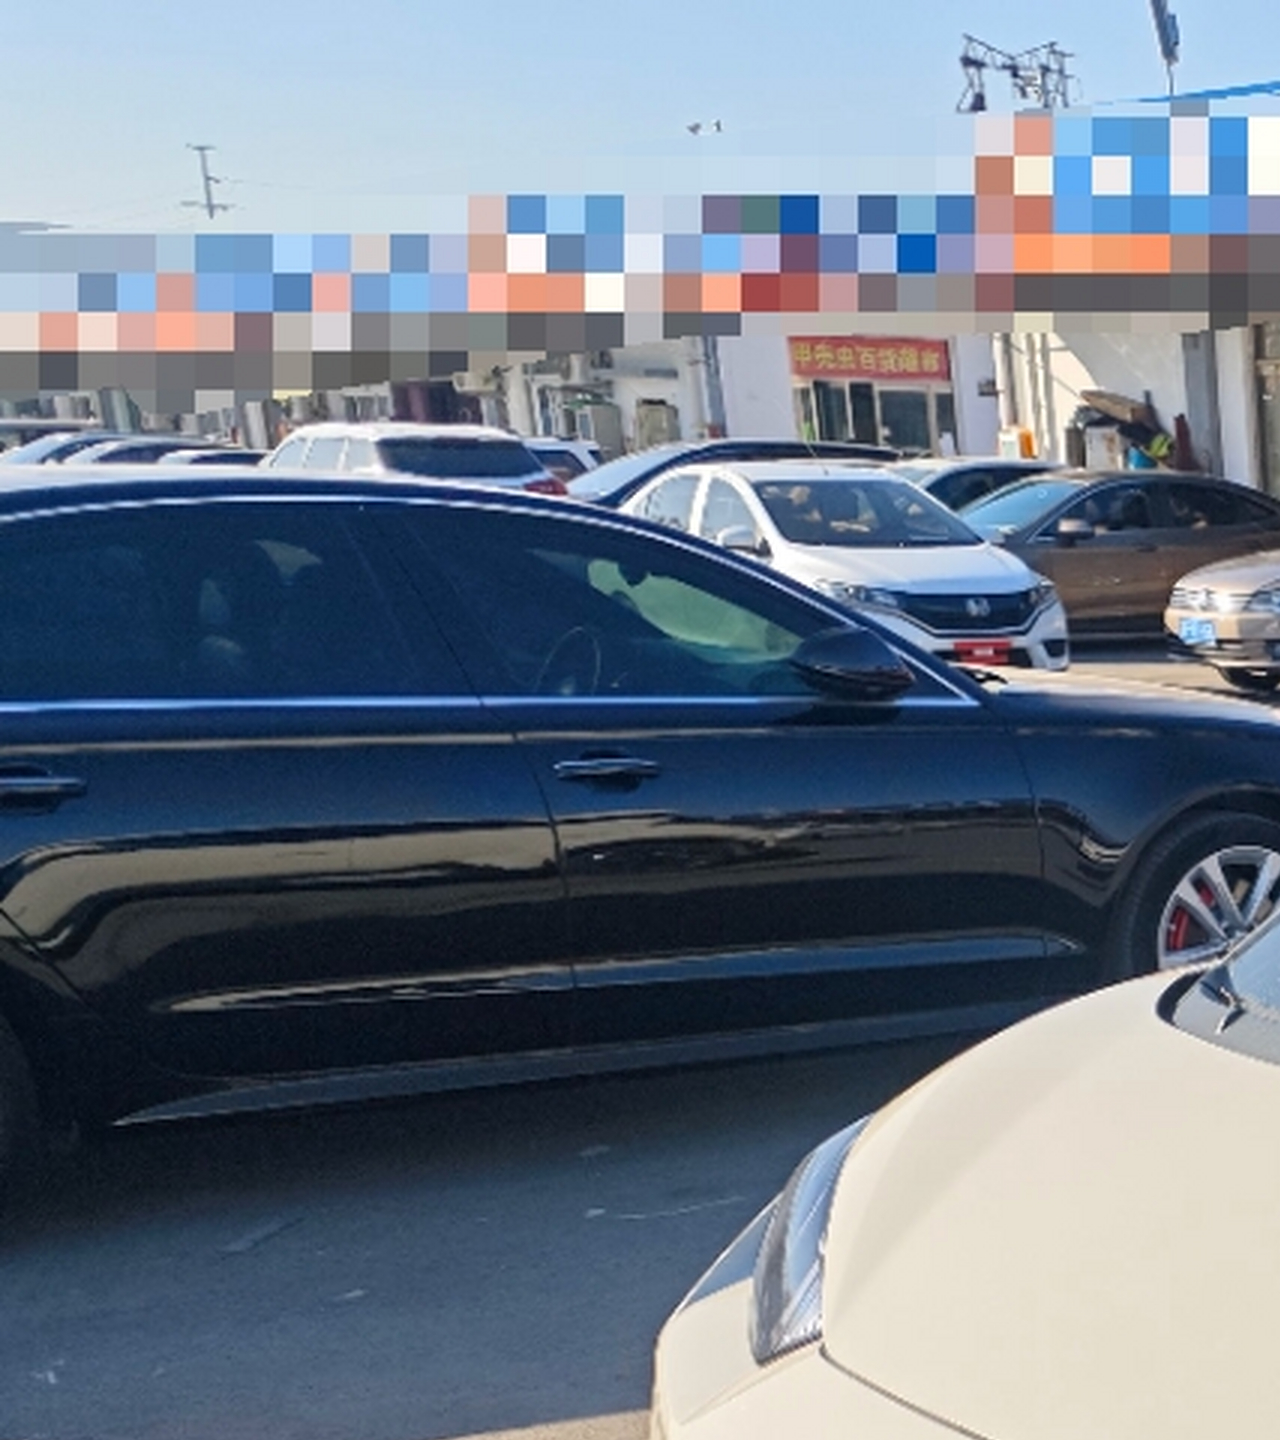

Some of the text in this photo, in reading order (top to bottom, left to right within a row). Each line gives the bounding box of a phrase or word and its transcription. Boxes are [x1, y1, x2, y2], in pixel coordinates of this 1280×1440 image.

[794, 342, 940, 373] 甲壳虫百货超市
